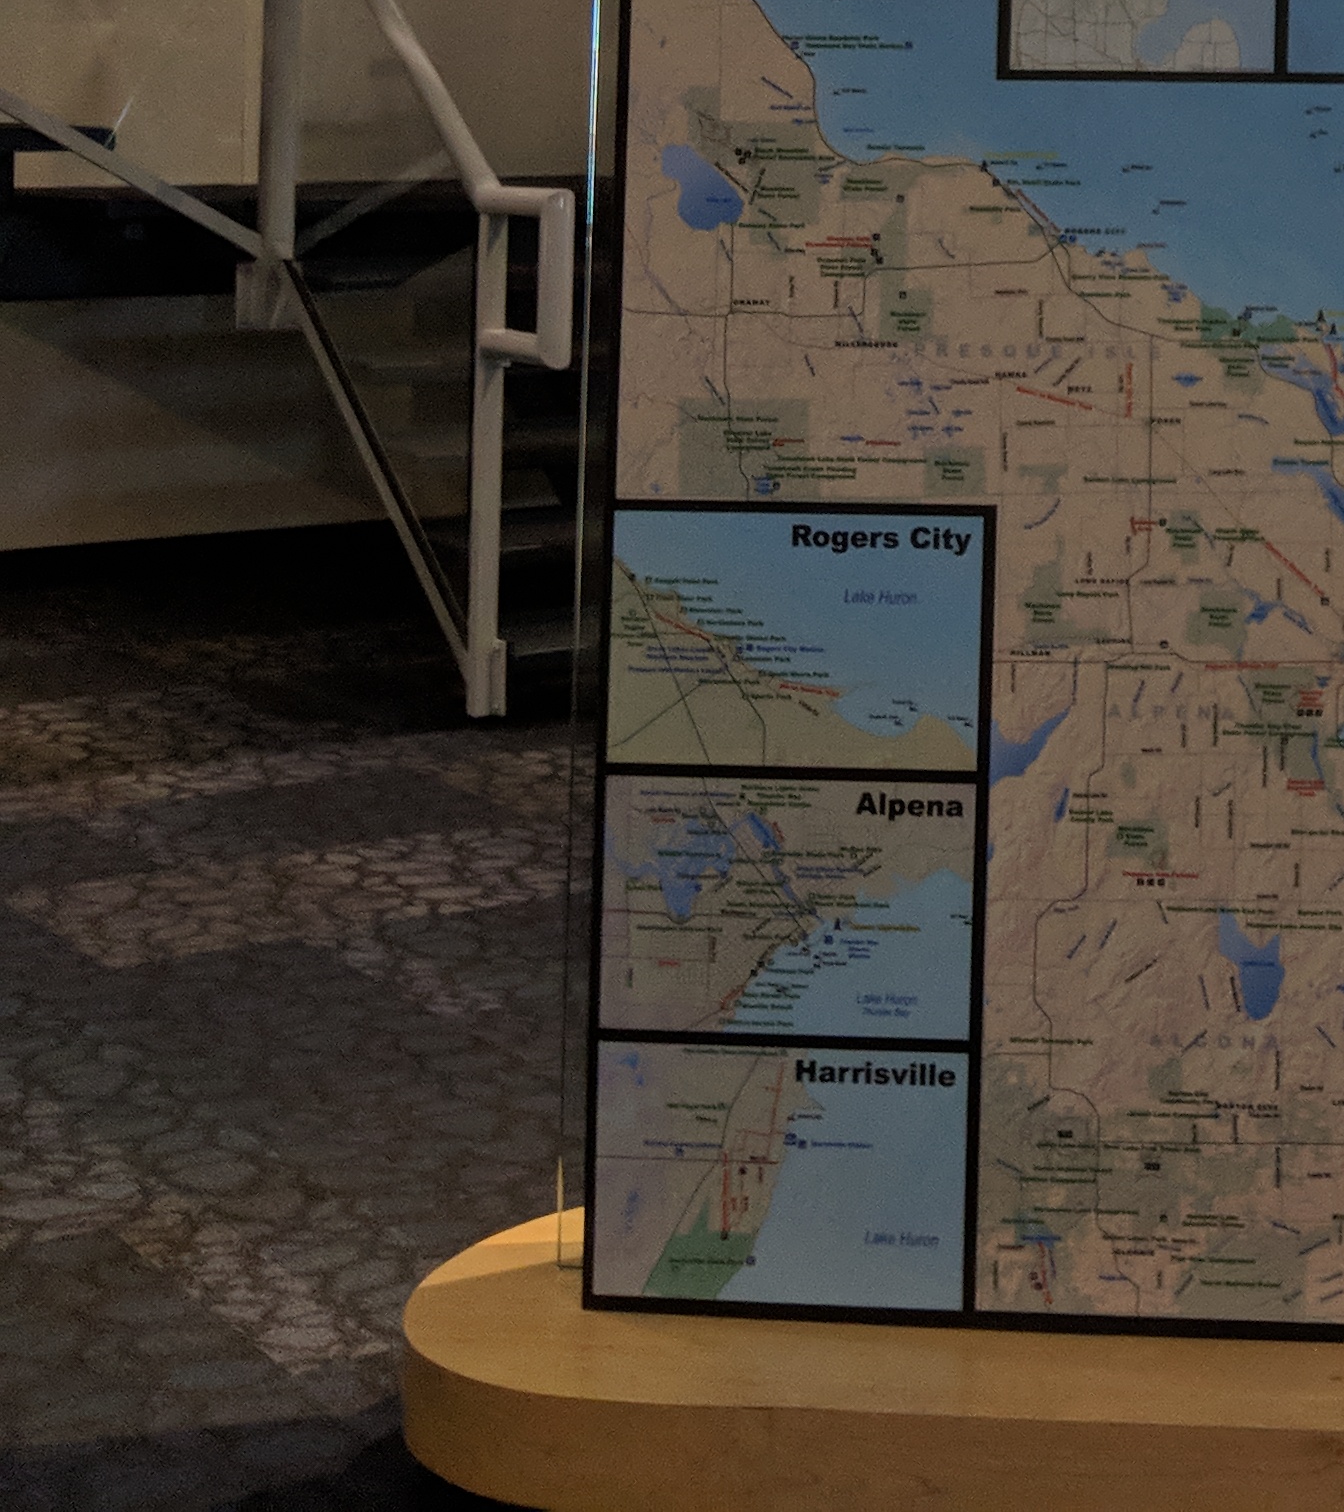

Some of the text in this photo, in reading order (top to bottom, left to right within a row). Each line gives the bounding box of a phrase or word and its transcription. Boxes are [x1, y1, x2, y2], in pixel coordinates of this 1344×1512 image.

[791, 524, 972, 556] Rogers City
[844, 589, 917, 605] Lake Huron
[856, 792, 964, 821] Alpena
[795, 1059, 956, 1088] Harrisville
[864, 1231, 895, 1246] Lake
